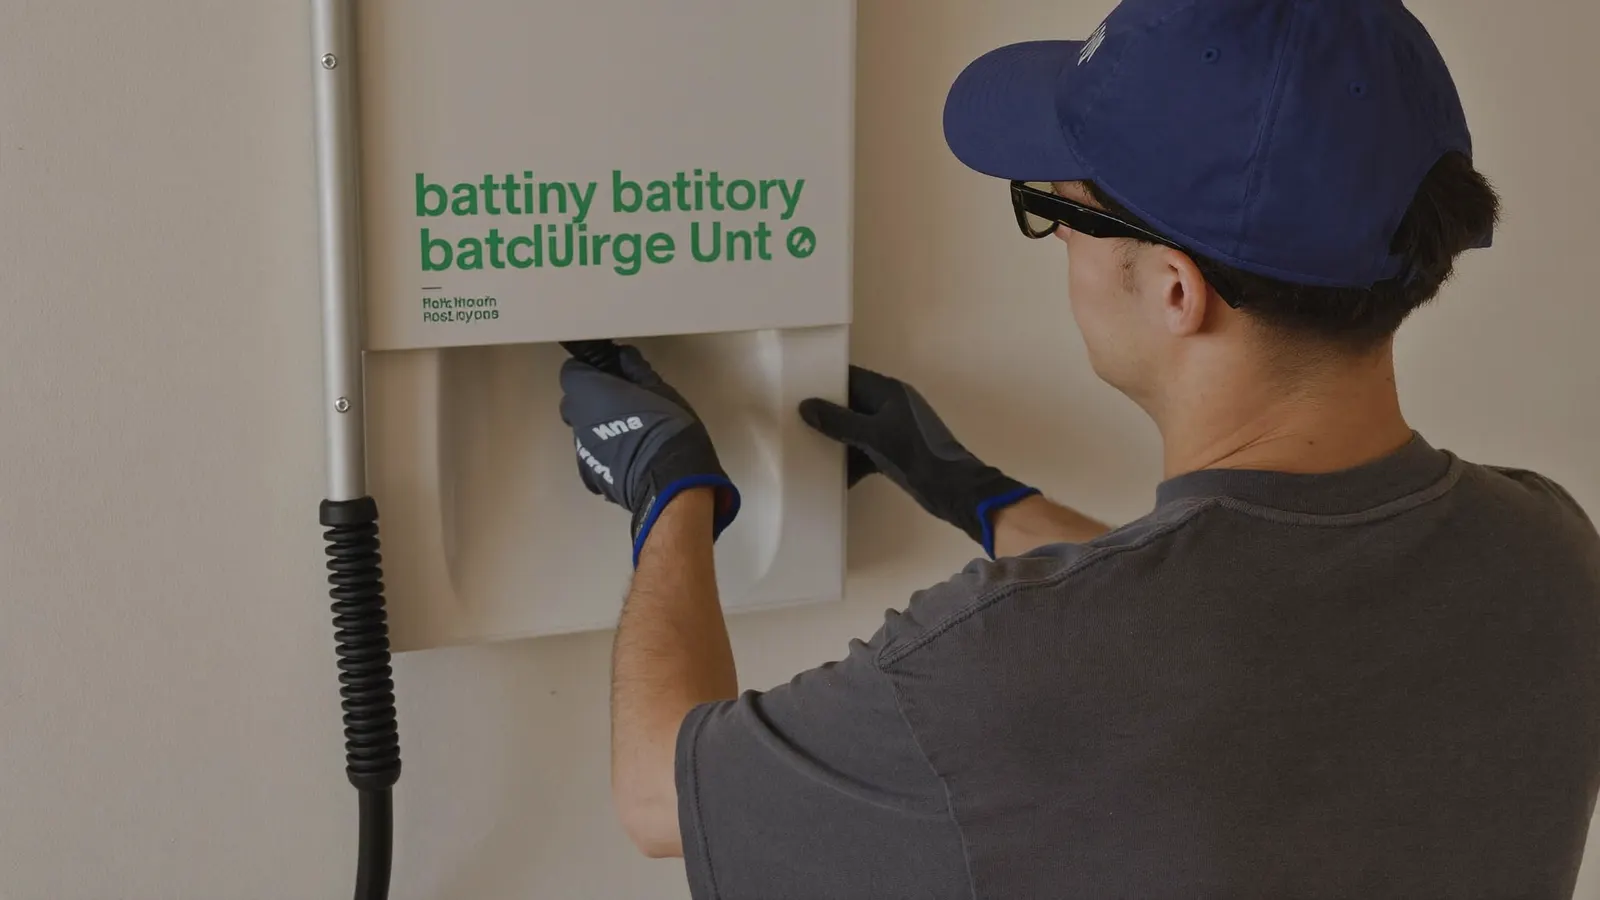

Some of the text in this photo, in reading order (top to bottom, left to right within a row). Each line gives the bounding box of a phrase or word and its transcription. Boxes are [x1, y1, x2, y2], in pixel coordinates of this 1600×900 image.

[415, 168, 805, 224] battiny batitory
[690, 221, 772, 263] Unt
